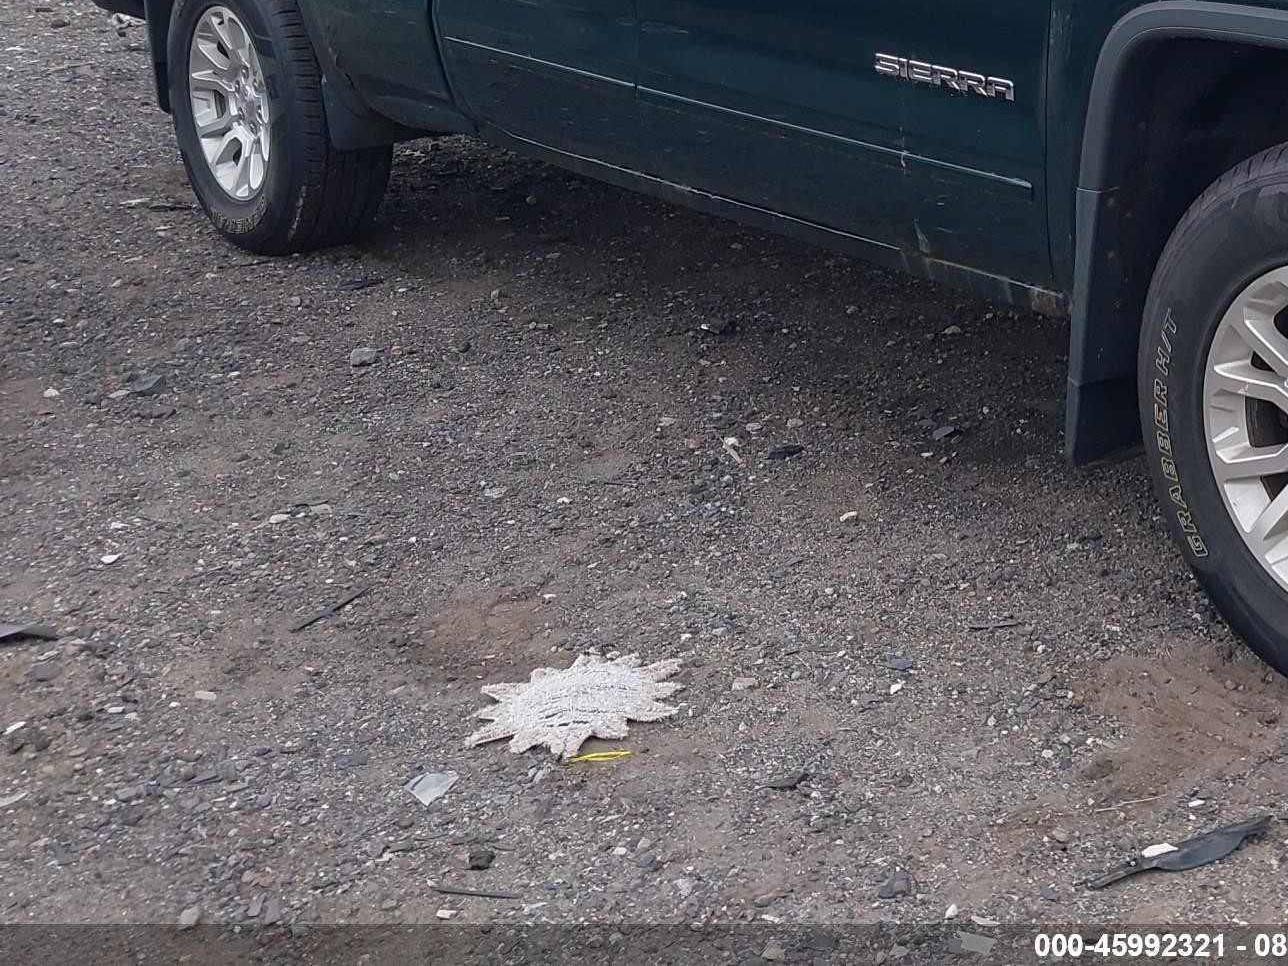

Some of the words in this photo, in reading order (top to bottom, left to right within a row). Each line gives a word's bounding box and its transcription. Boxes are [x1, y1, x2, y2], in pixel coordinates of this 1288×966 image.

[874, 52, 1015, 101] SIERRA
[1155, 307, 1178, 377] H/T
[1154, 379, 1209, 557] GRABBER
